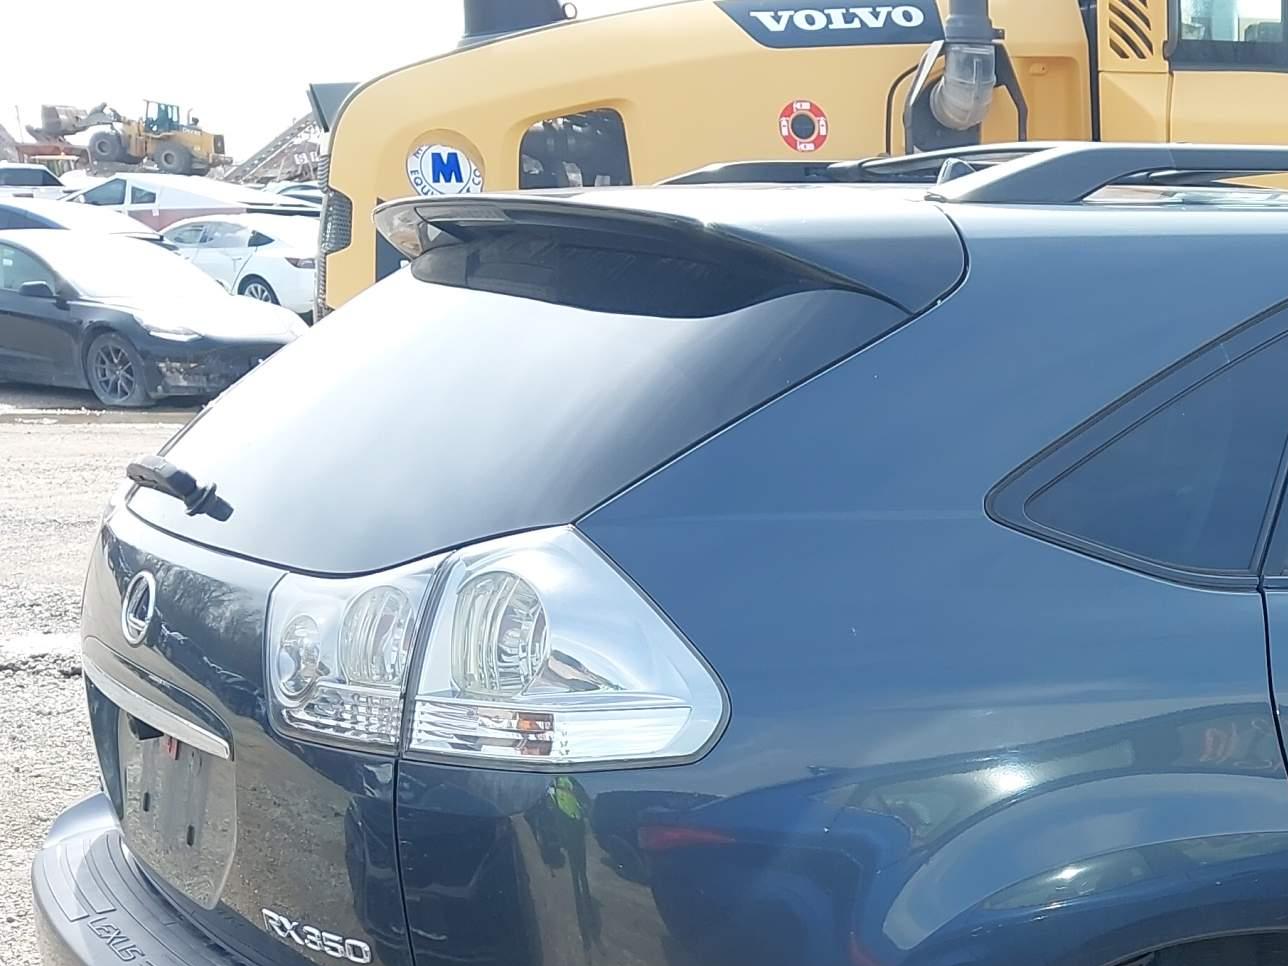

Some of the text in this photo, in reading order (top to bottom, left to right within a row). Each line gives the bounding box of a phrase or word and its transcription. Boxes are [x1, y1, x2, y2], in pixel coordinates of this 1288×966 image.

[750, 6, 925, 32] VOLVO
[431, 152, 464, 183] M
[87, 916, 146, 962] LEXUS
[262, 908, 372, 964] RX350
